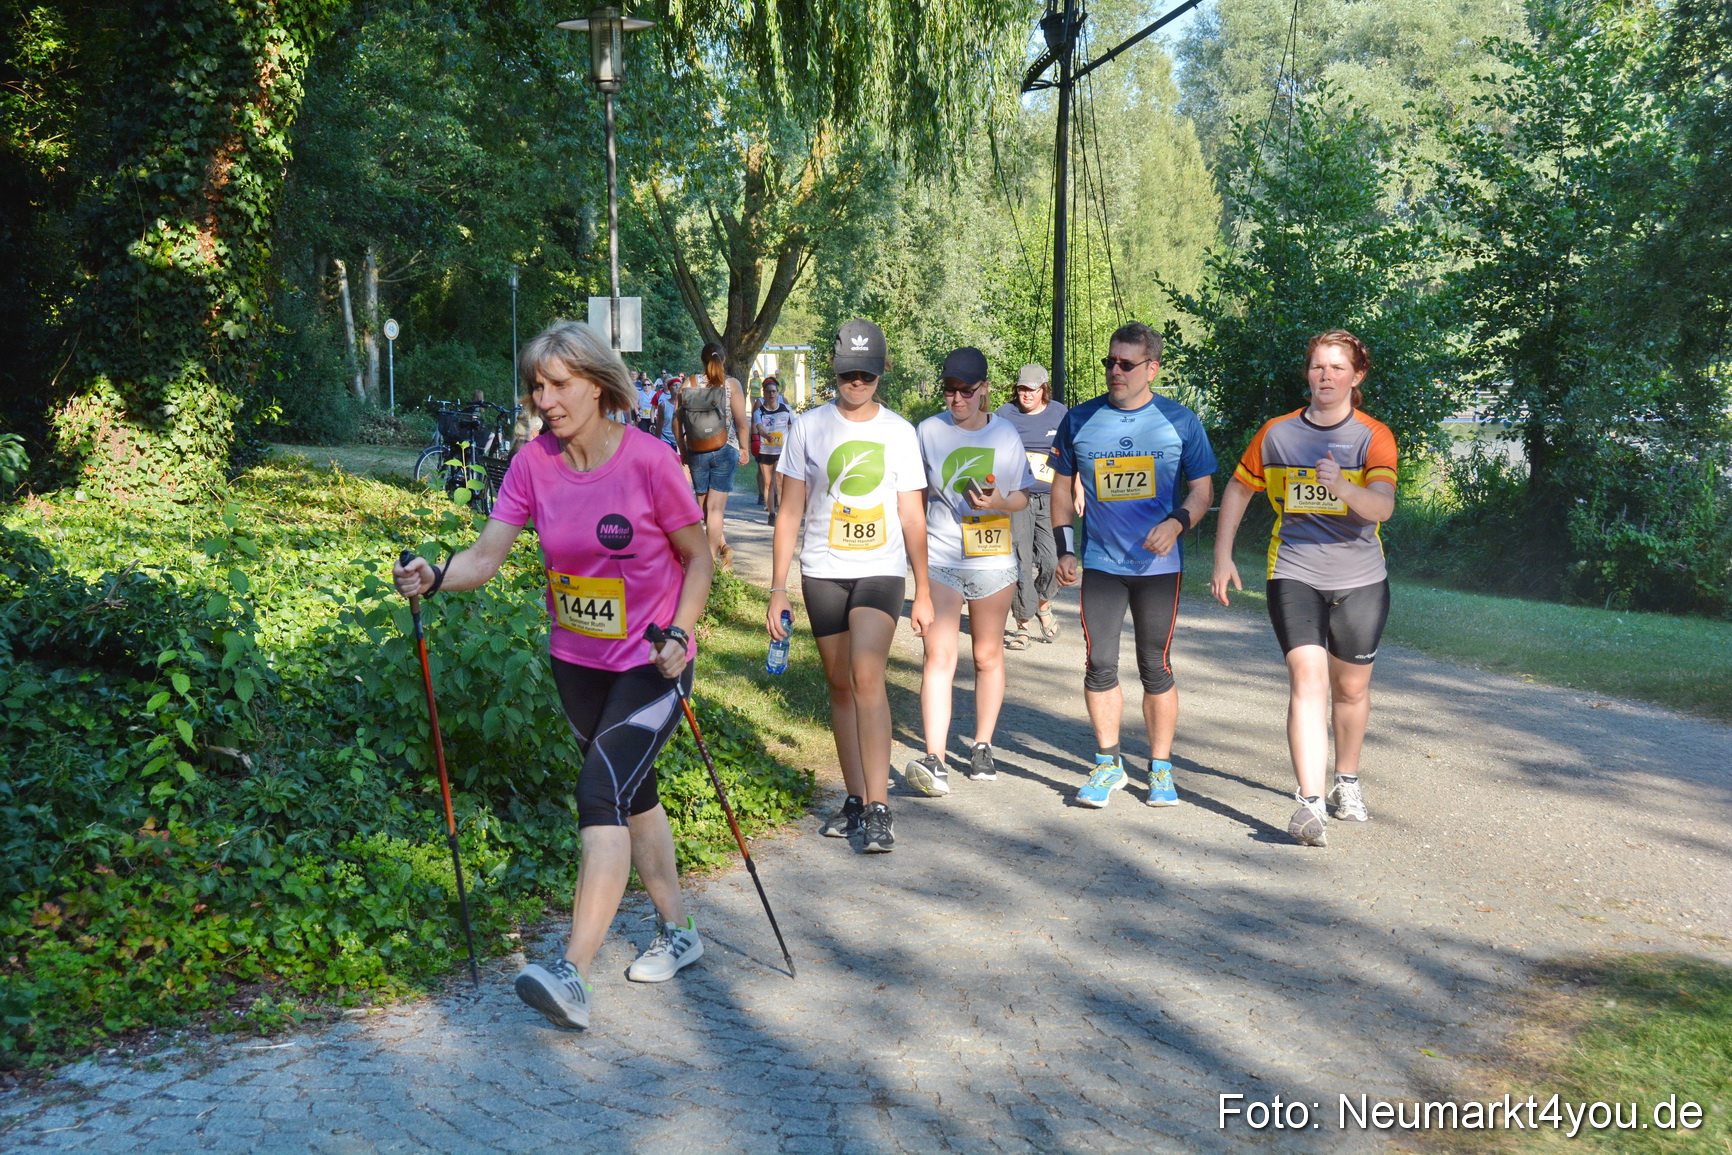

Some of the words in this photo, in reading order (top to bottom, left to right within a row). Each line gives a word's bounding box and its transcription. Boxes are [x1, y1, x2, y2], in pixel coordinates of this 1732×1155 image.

[1104, 472, 1147, 489] 1772
[842, 522, 876, 539] 188
[975, 529, 1002, 544] 187
[560, 593, 615, 622] 1444
